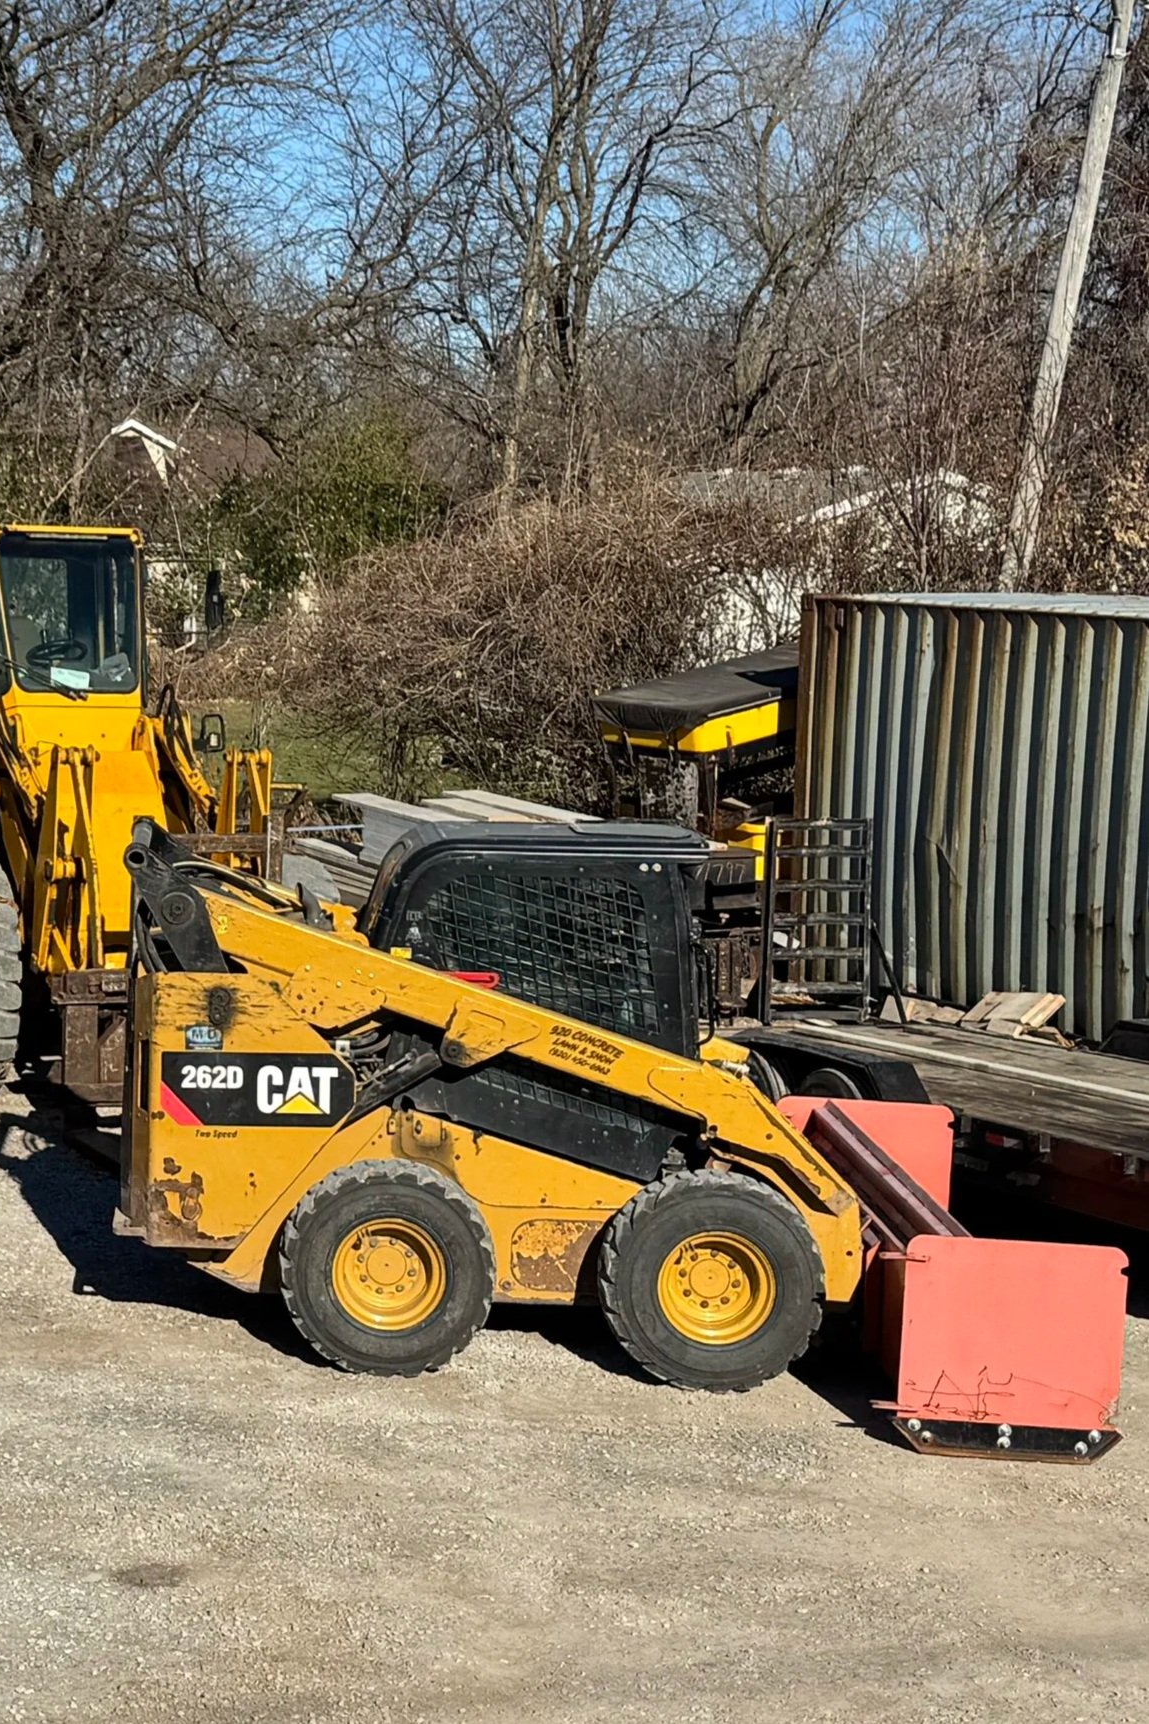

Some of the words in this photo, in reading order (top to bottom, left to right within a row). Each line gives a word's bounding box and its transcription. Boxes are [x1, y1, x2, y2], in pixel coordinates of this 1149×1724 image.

[549, 1025, 572, 1037] 920
[572, 1031, 625, 1059] CONCRETE
[552, 1038, 579, 1052] LAWN
[579, 1047, 588, 1056] &
[586, 1050, 615, 1066] SNOW
[181, 1065, 244, 1090] 262D
[257, 1065, 339, 1115] CAT
[195, 1129, 211, 1138] Two
[213, 1129, 238, 1139] Speed
